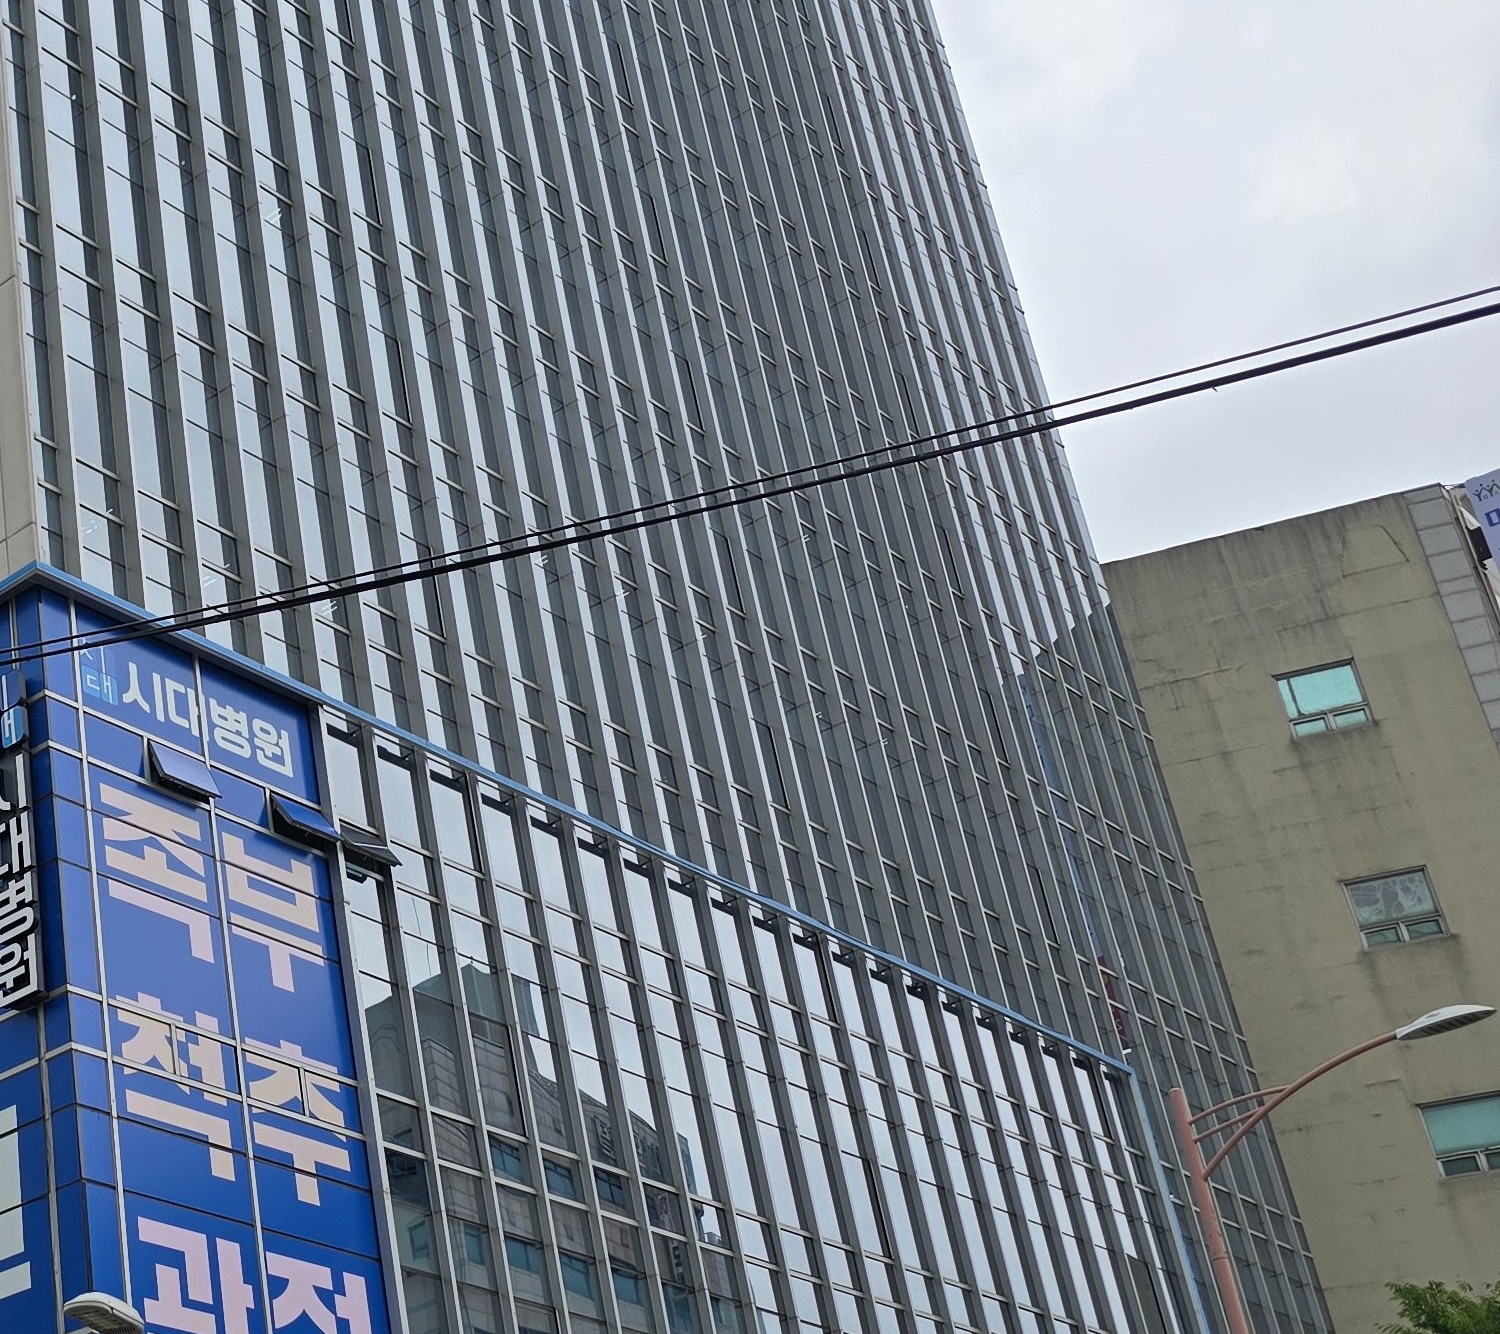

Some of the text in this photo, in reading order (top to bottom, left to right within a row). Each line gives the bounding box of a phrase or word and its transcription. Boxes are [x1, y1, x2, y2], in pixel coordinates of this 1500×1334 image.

[122, 661, 294, 778] 시대병원
[100, 782, 326, 992] 족부
[116, 995, 353, 1207] 척추
